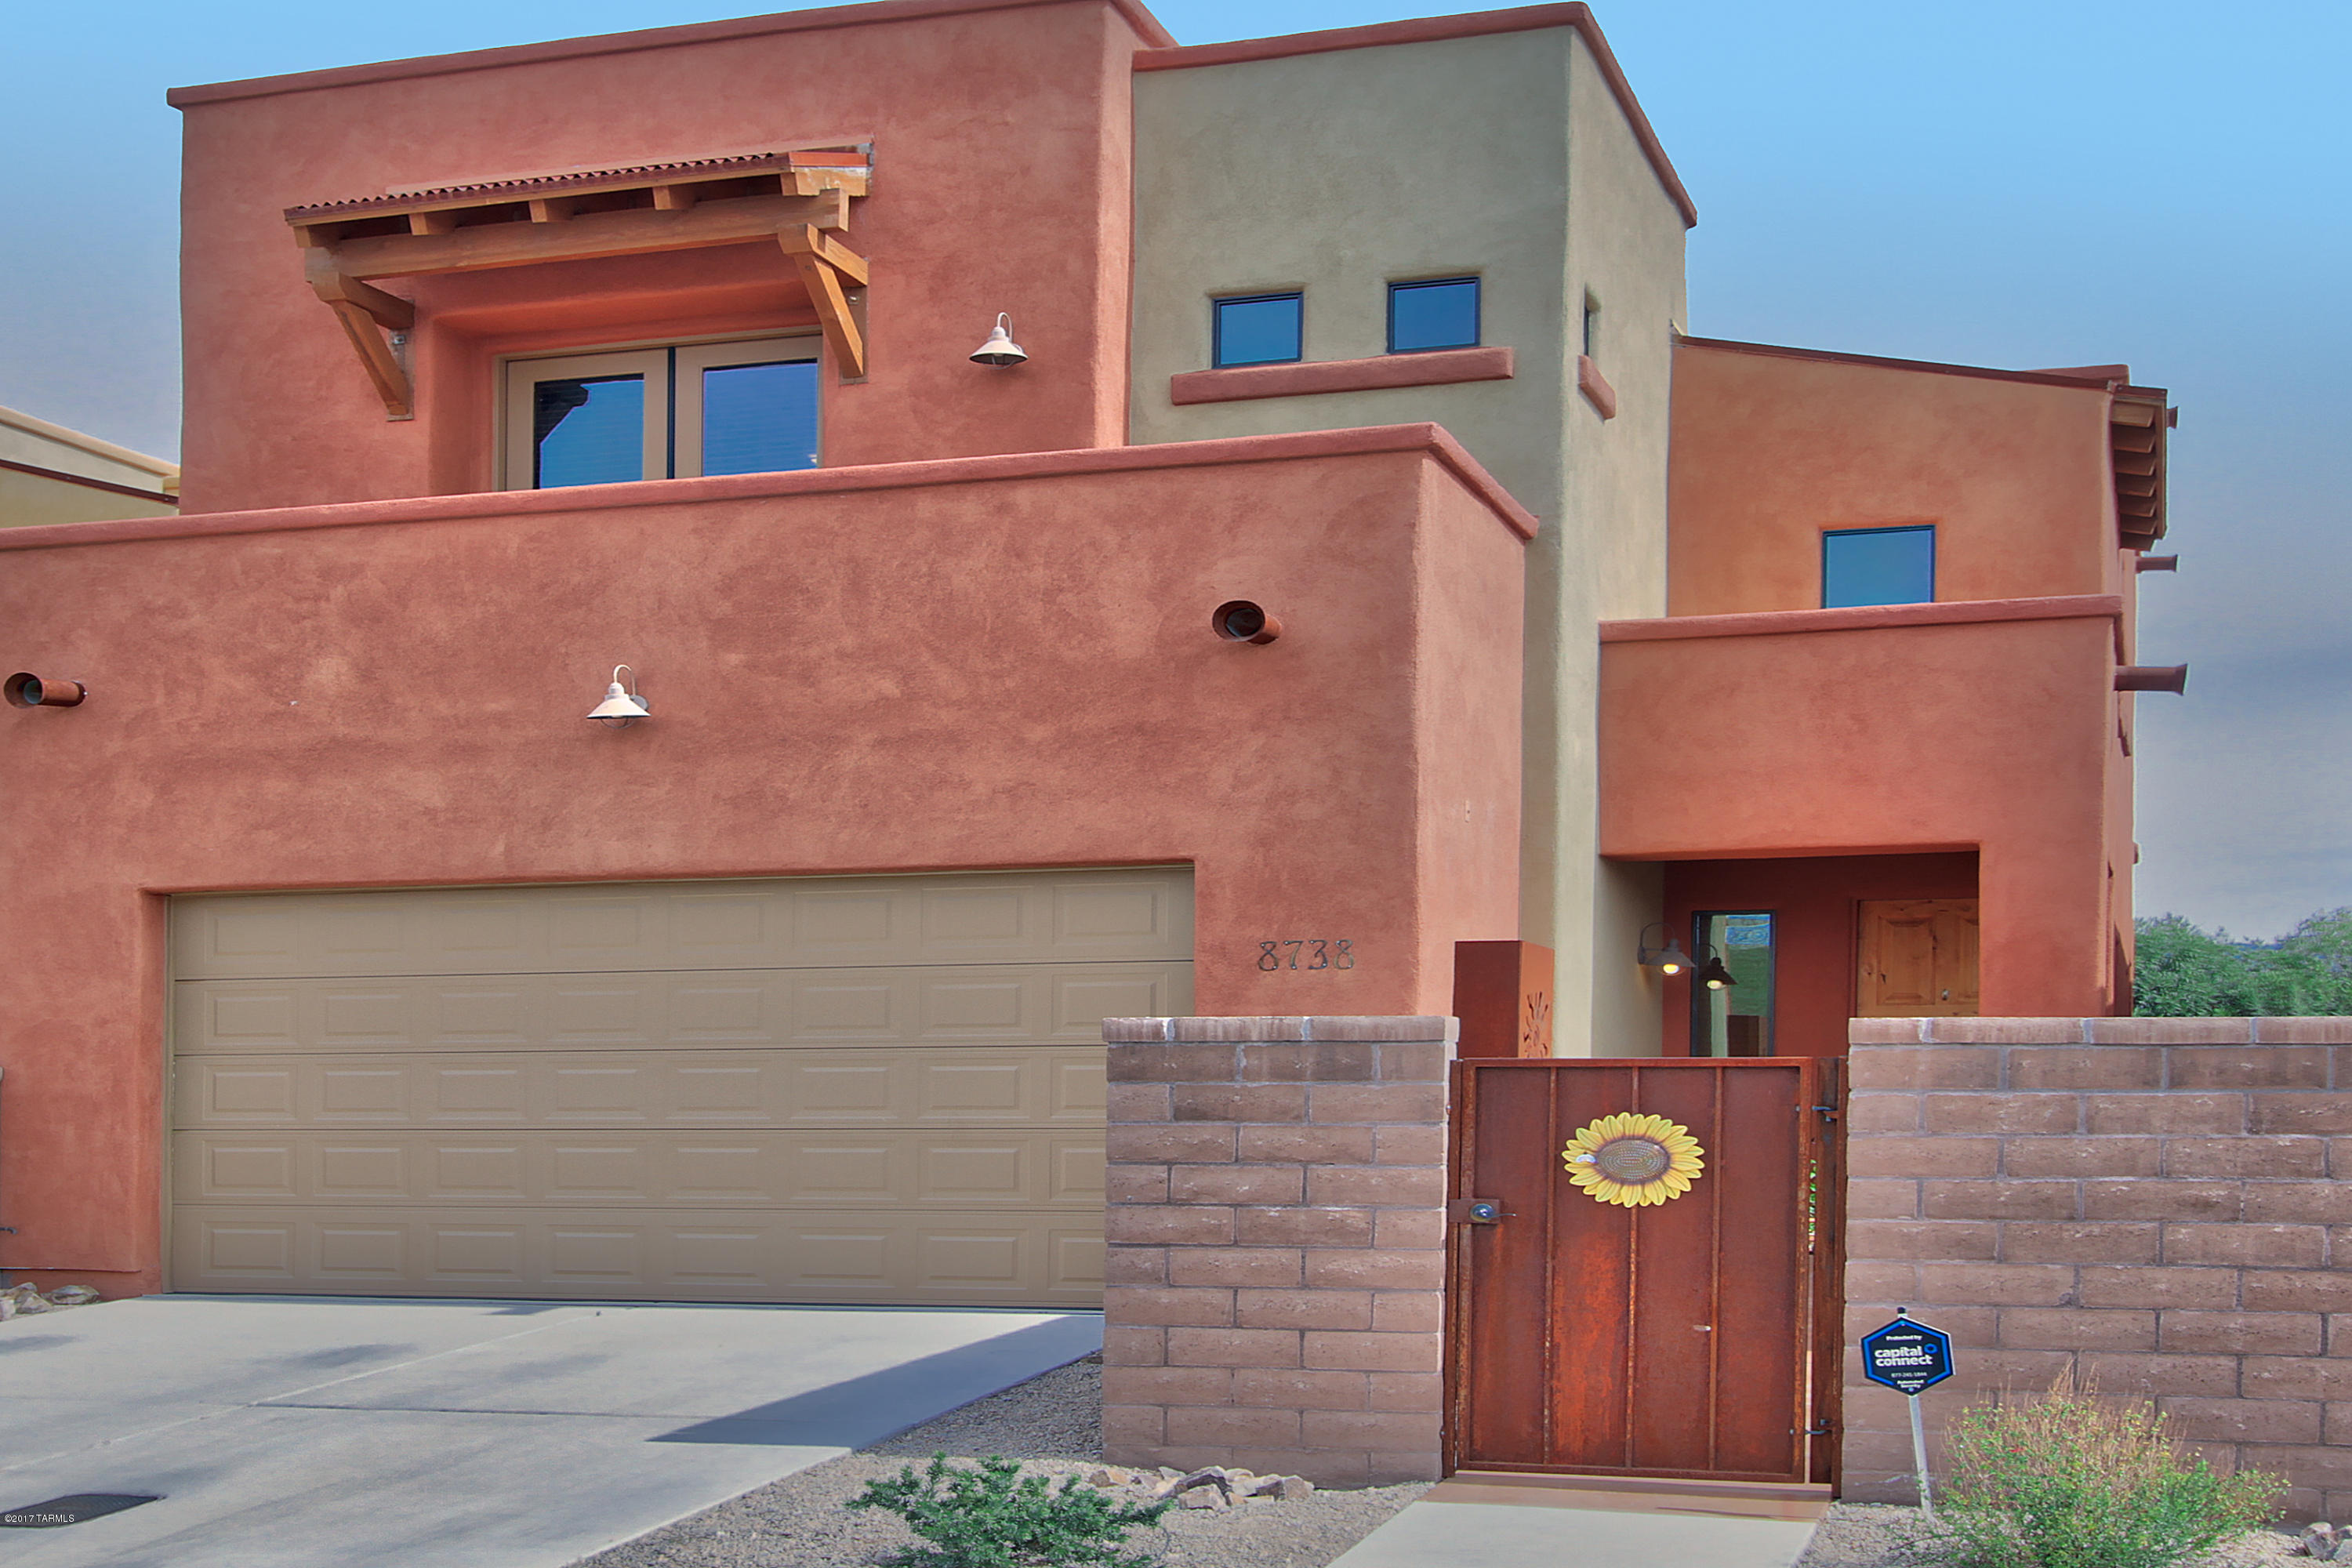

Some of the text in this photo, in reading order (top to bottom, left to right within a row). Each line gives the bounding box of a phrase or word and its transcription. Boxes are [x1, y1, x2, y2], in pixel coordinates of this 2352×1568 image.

[1258, 939, 1355, 971] 8738
[1875, 1345, 1923, 1359] capital
[1875, 1355, 1933, 1367] connect
